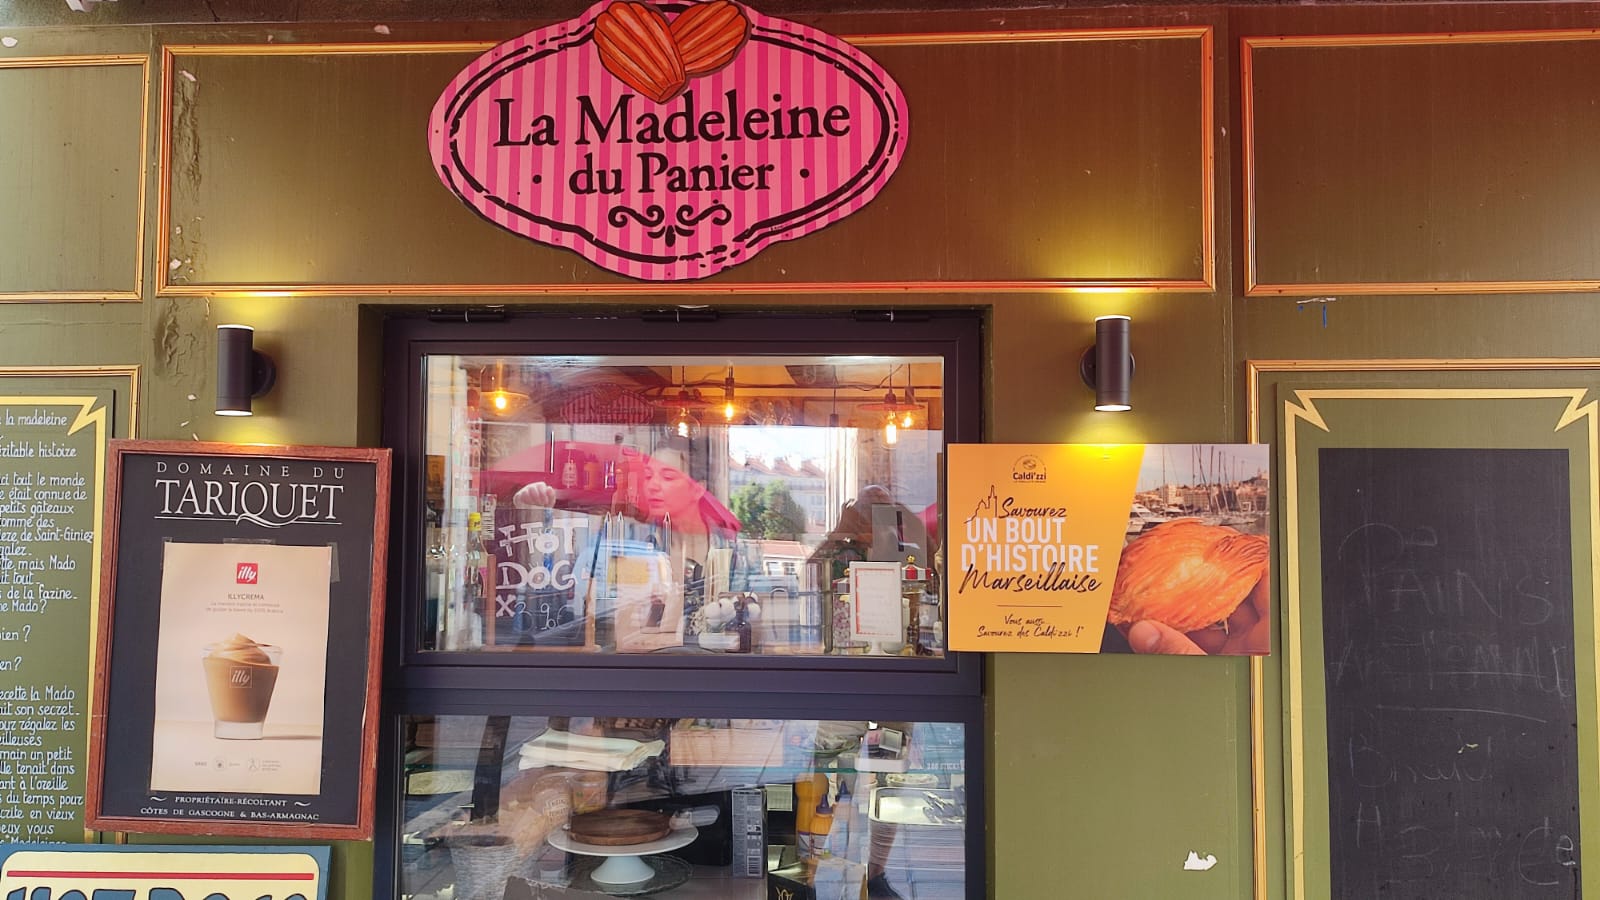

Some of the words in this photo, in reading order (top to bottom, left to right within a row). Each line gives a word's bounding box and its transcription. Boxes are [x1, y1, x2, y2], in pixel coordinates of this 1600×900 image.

[493, 98, 559, 147] La
[575, 89, 850, 145] Madeleine
[569, 152, 625, 195] du
[637, 152, 775, 193] Panier
[6, 408, 15, 426] la
[17, 408, 68, 426] madeleine
[0, 441, 35, 458] ritable
[157, 462, 291, 478] DOMAINE
[313, 467, 344, 479] DU
[13, 472, 33, 486] tout
[36, 472, 46, 486] le
[49, 472, 86, 486] monde
[8, 486, 32, 500] était
[34, 490, 72, 500] connue
[73, 487, 88, 500] de
[30, 501, 74, 518] gâteaux
[154, 479, 345, 528] TARIQUET
[999, 497, 1068, 519] Savourez
[36, 514, 55, 528] des
[21, 528, 33, 541] de
[498, 517, 589, 557] HOT
[966, 518, 998, 543] UN
[1006, 517, 1066, 543] BOUT
[18, 558, 45, 570] mais
[50, 554, 76, 570] Mado
[961, 543, 1099, 573] D'HISTOIRE
[238, 566, 257, 583] illy
[496, 559, 578, 590] DOG
[958, 562, 1102, 594] Marseillaise
[7, 585, 20, 599] de
[23, 586, 35, 599] la
[1004, 613, 1023, 625] Vous
[977, 625, 1013, 638] Savourez
[231, 670, 250, 686] illy
[30, 686, 40, 701] la
[44, 685, 75, 700] Mado
[15, 705, 34, 715] son
[61, 716, 76, 730] les
[30, 751, 44, 760] un
[46, 746, 72, 766] petit
[16, 760, 48, 775] tenait
[50, 761, 76, 775] dans
[6, 789, 20, 804] du
[22, 791, 55, 808] temps
[29, 809, 43, 819] en
[46, 807, 75, 820] vieux
[140, 807, 169, 815] CÔTES
[172, 808, 185, 816] DE
[188, 809, 236, 818] GASCOGNE
[250, 811, 320, 820] BAS-ARMAGNAC
[26, 824, 56, 834] vous
